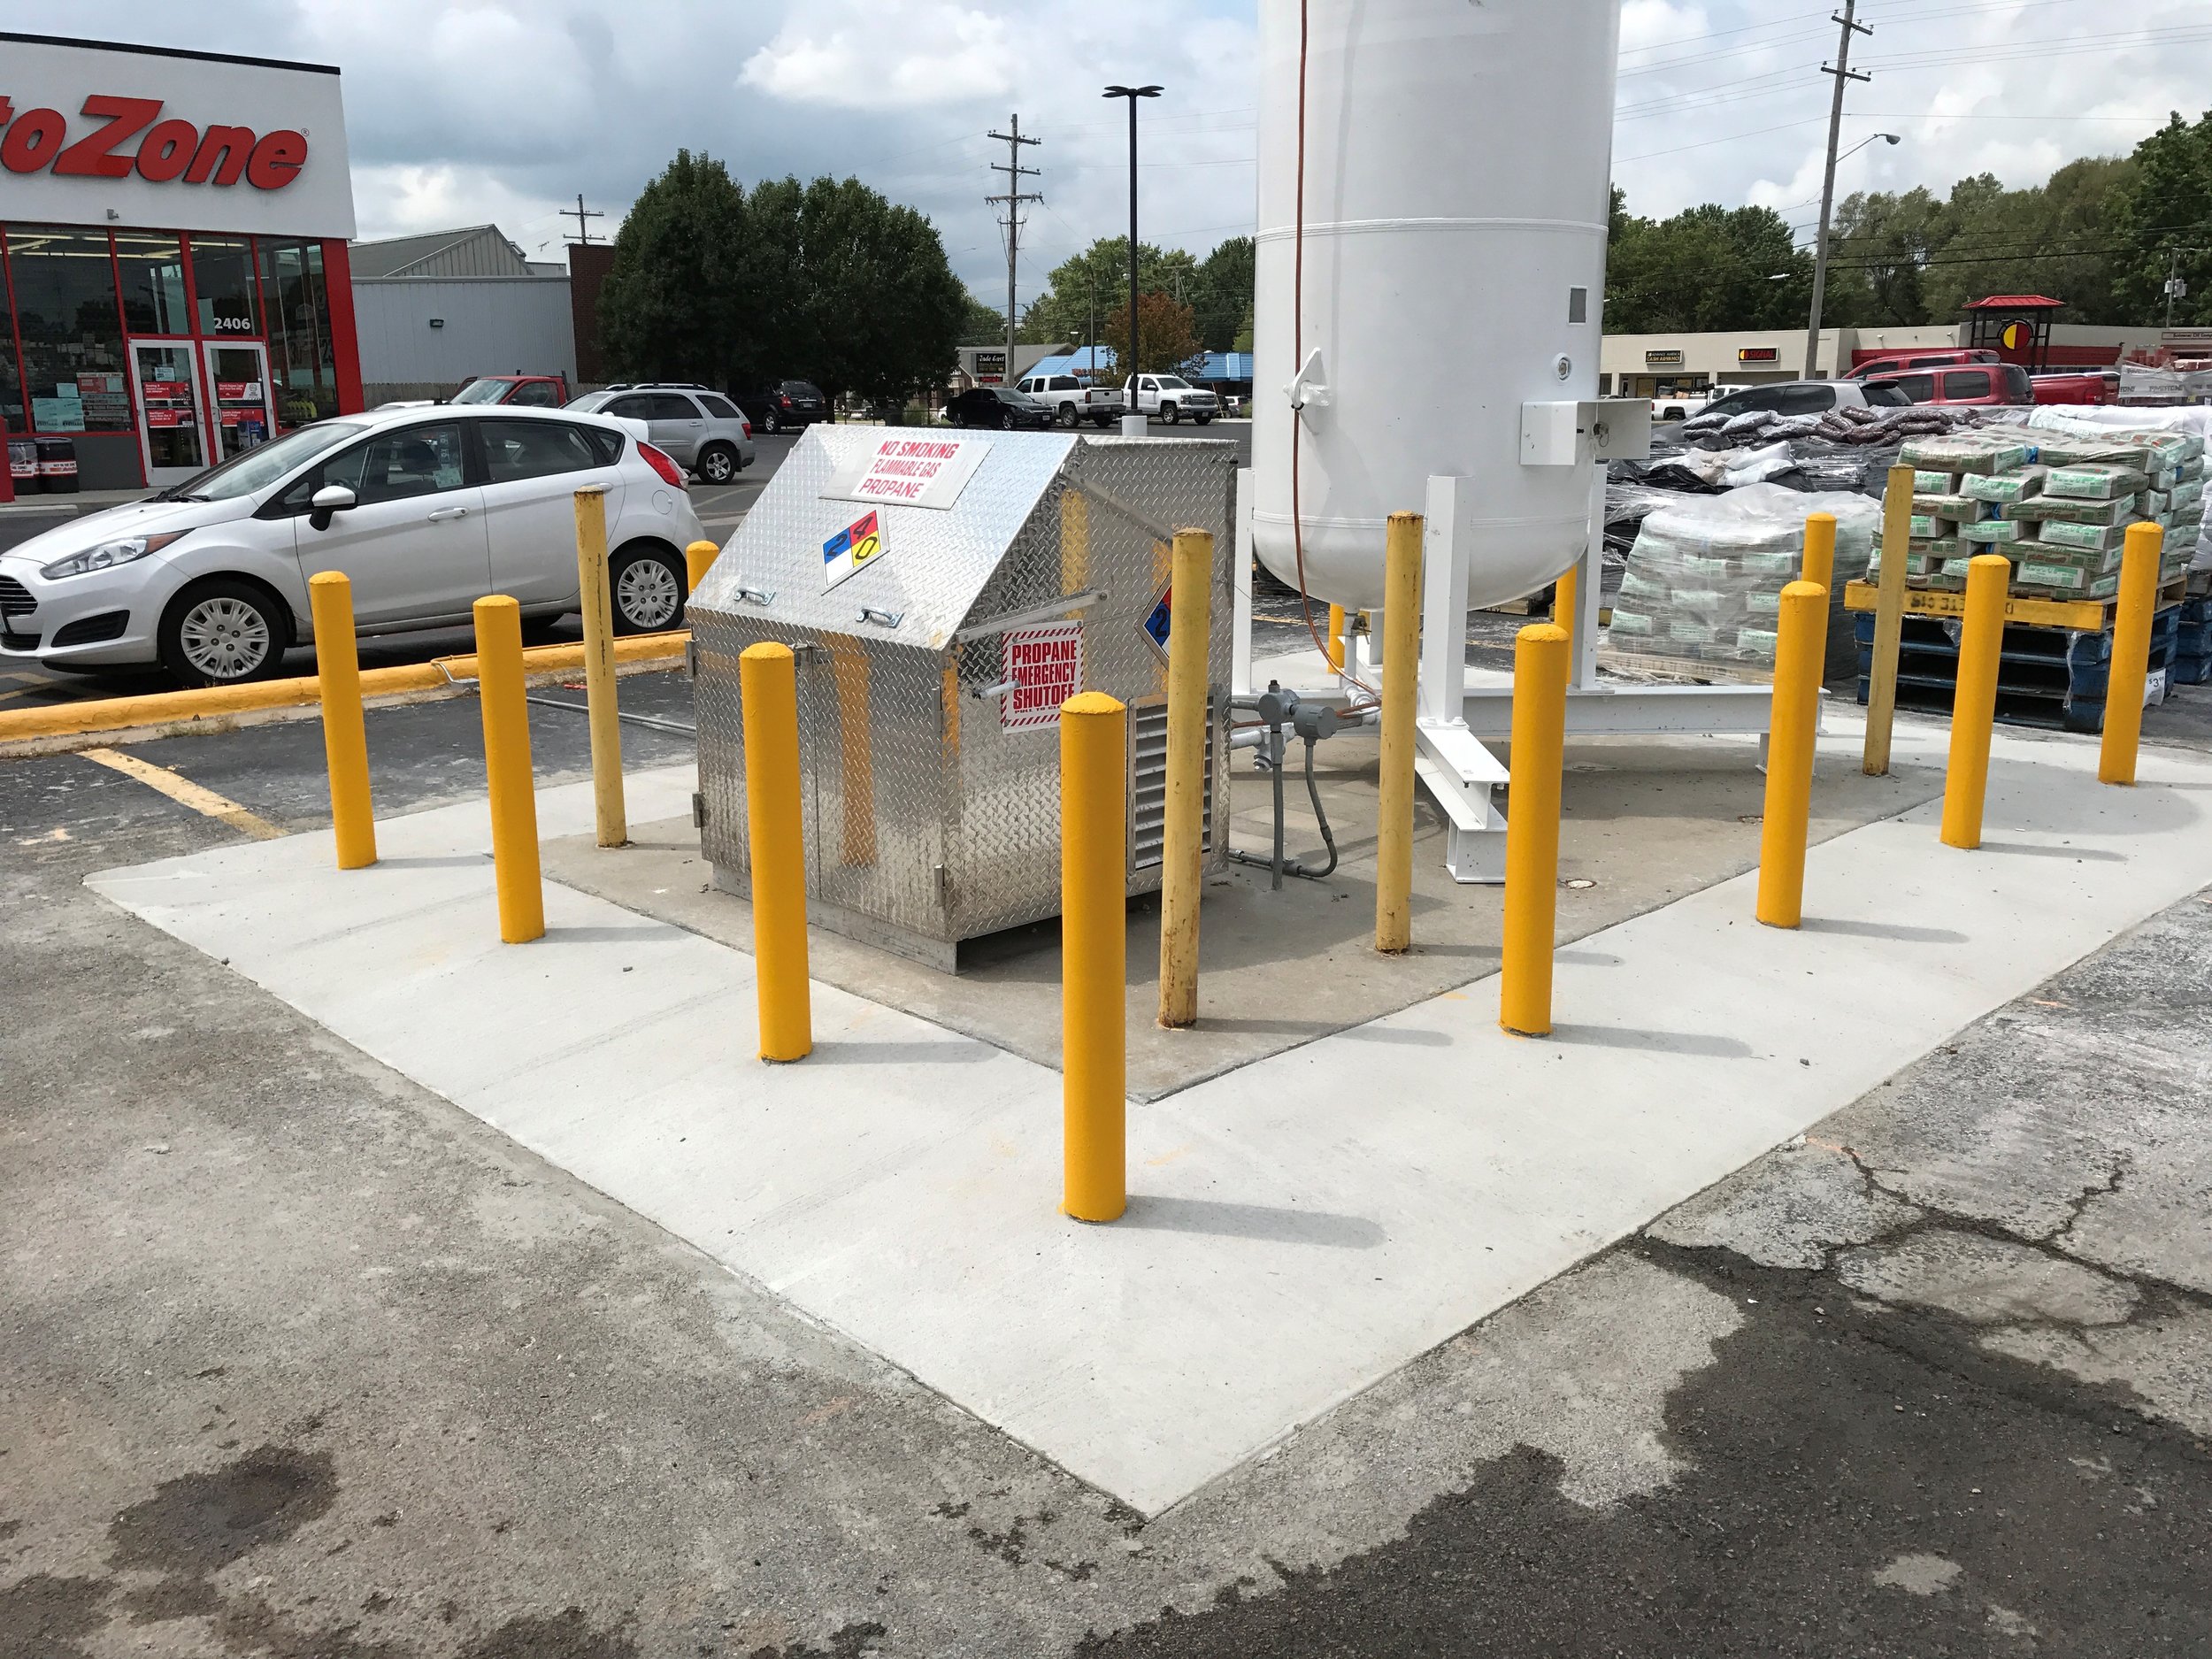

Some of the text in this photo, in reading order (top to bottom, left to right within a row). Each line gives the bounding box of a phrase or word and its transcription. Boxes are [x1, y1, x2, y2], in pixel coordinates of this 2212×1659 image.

[213, 317, 251, 330] 2406
[877, 441, 960, 459] NO SMOKING
[869, 458, 941, 478] FLAMMABLE GAS
[858, 478, 925, 498] PROPANE
[853, 516, 874, 540] 4
[826, 534, 849, 557] 2
[855, 536, 879, 559] 0
[1155, 608, 1168, 637] 2
[1011, 640, 1077, 666] PROPANE
[1011, 662, 1077, 687] EMERGENCY
[1013, 683, 1075, 710] SHUTOFF
